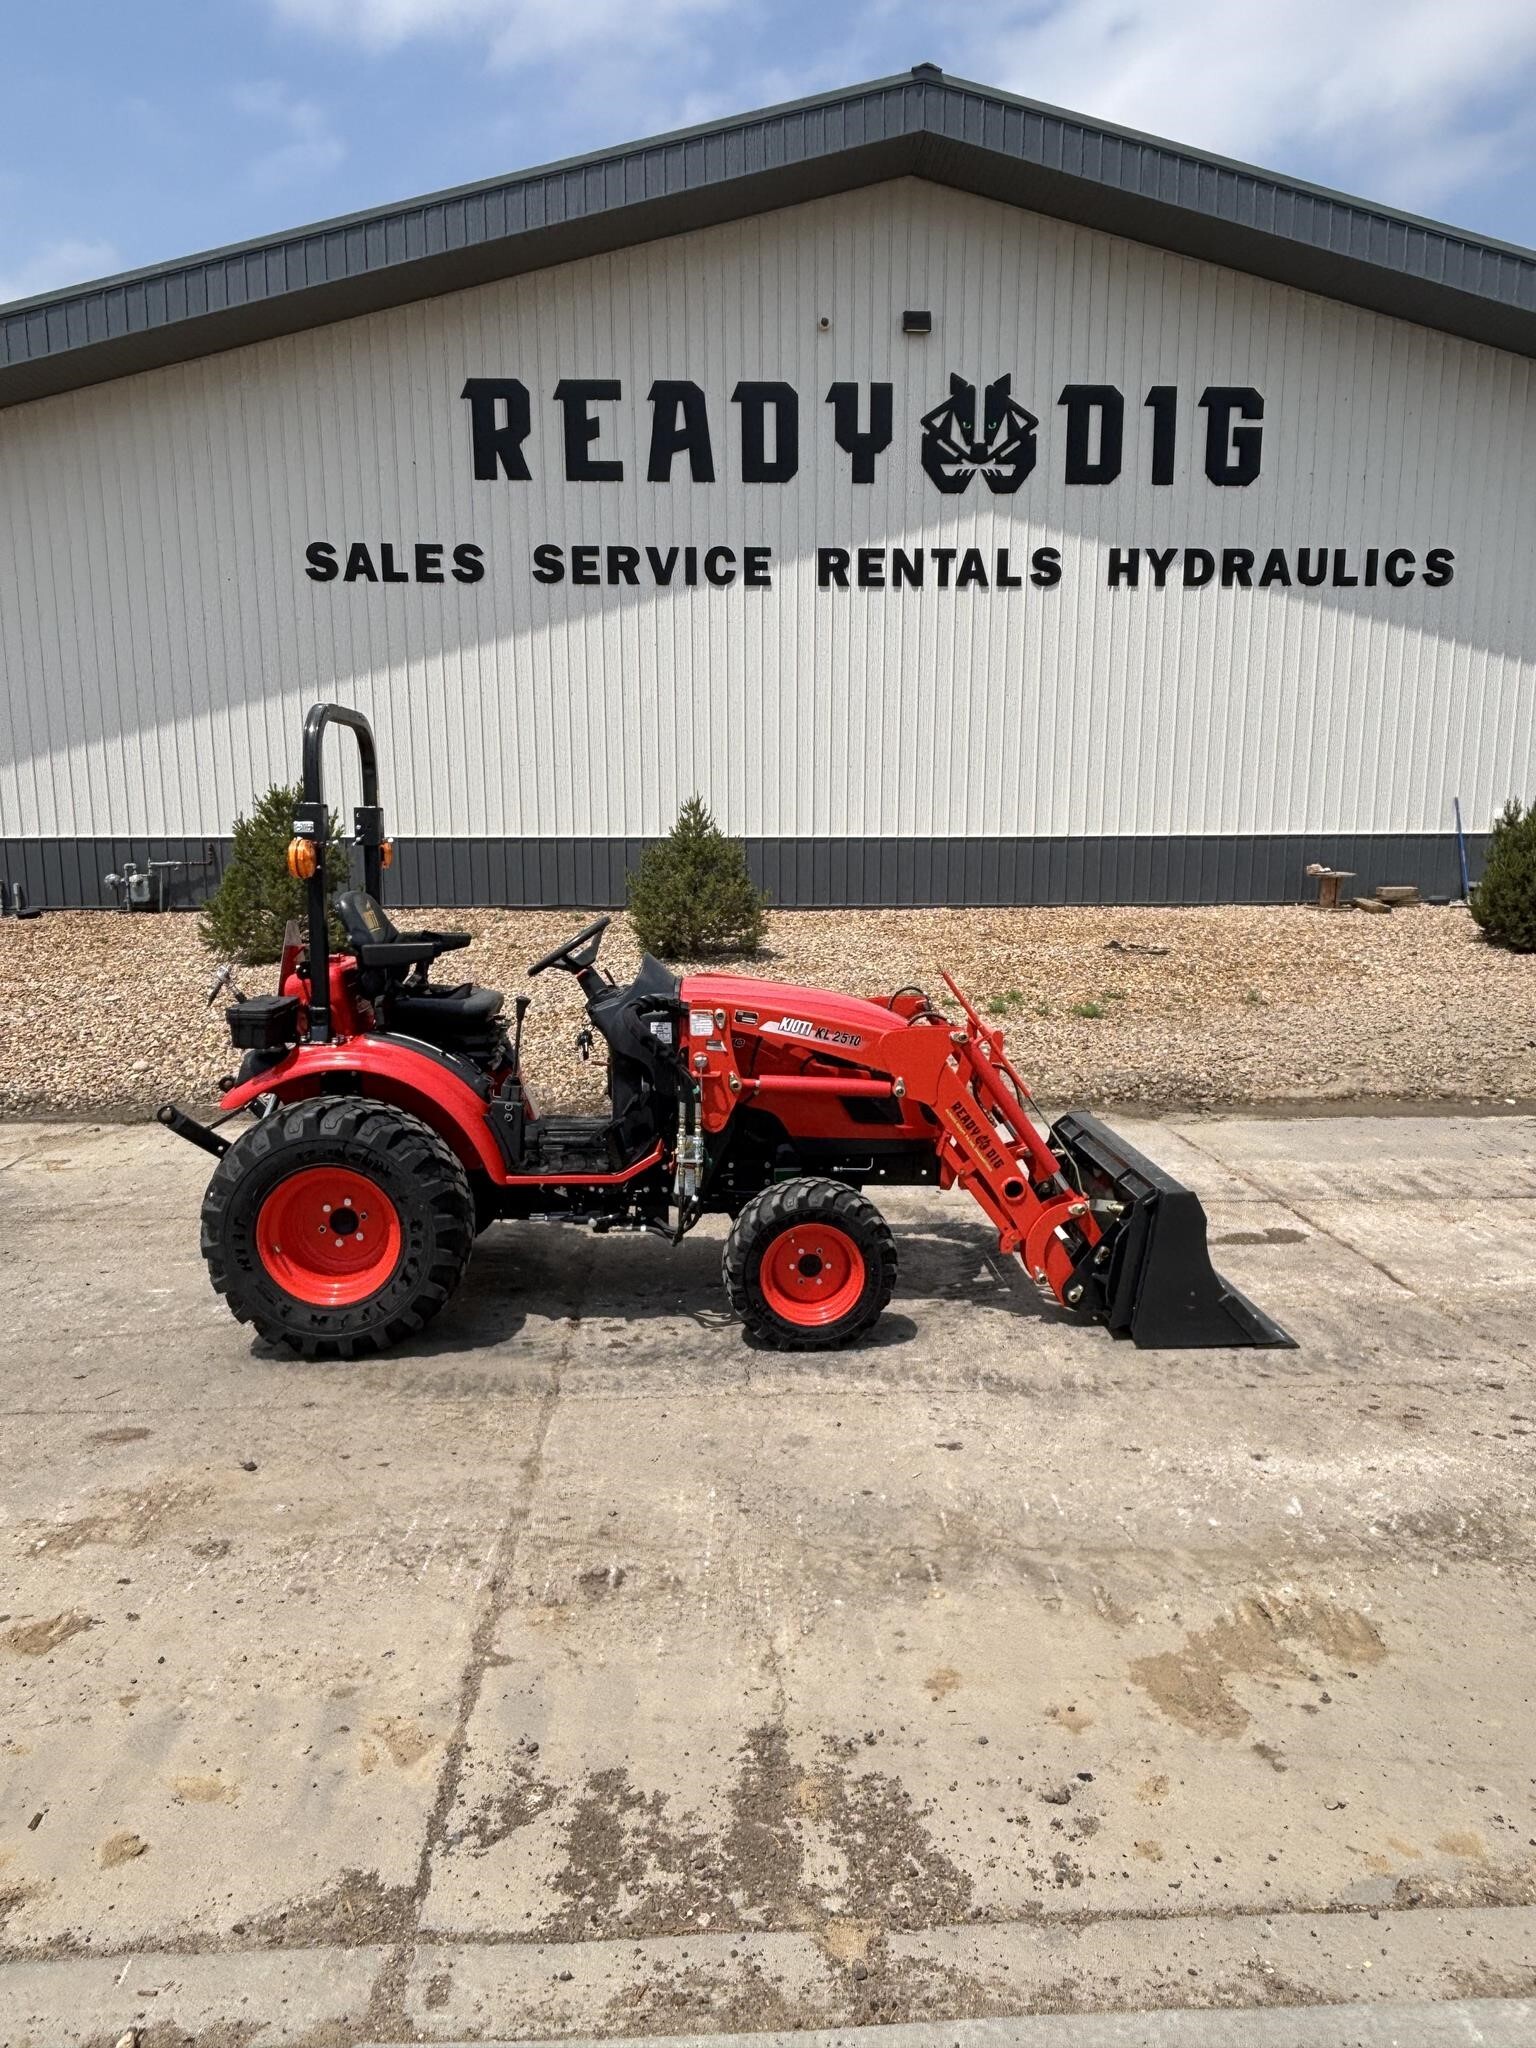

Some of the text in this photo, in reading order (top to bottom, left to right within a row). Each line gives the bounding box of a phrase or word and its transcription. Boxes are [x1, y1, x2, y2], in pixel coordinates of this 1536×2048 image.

[461, 378, 1264, 486] READY DIG
[306, 542, 1454, 587] SALES SERVICE RENTALS HYDRAULICS
[779, 1017, 861, 1046] KIOTI KL 2510
[950, 1100, 981, 1136] READY
[985, 1147, 1005, 1169] DIG
